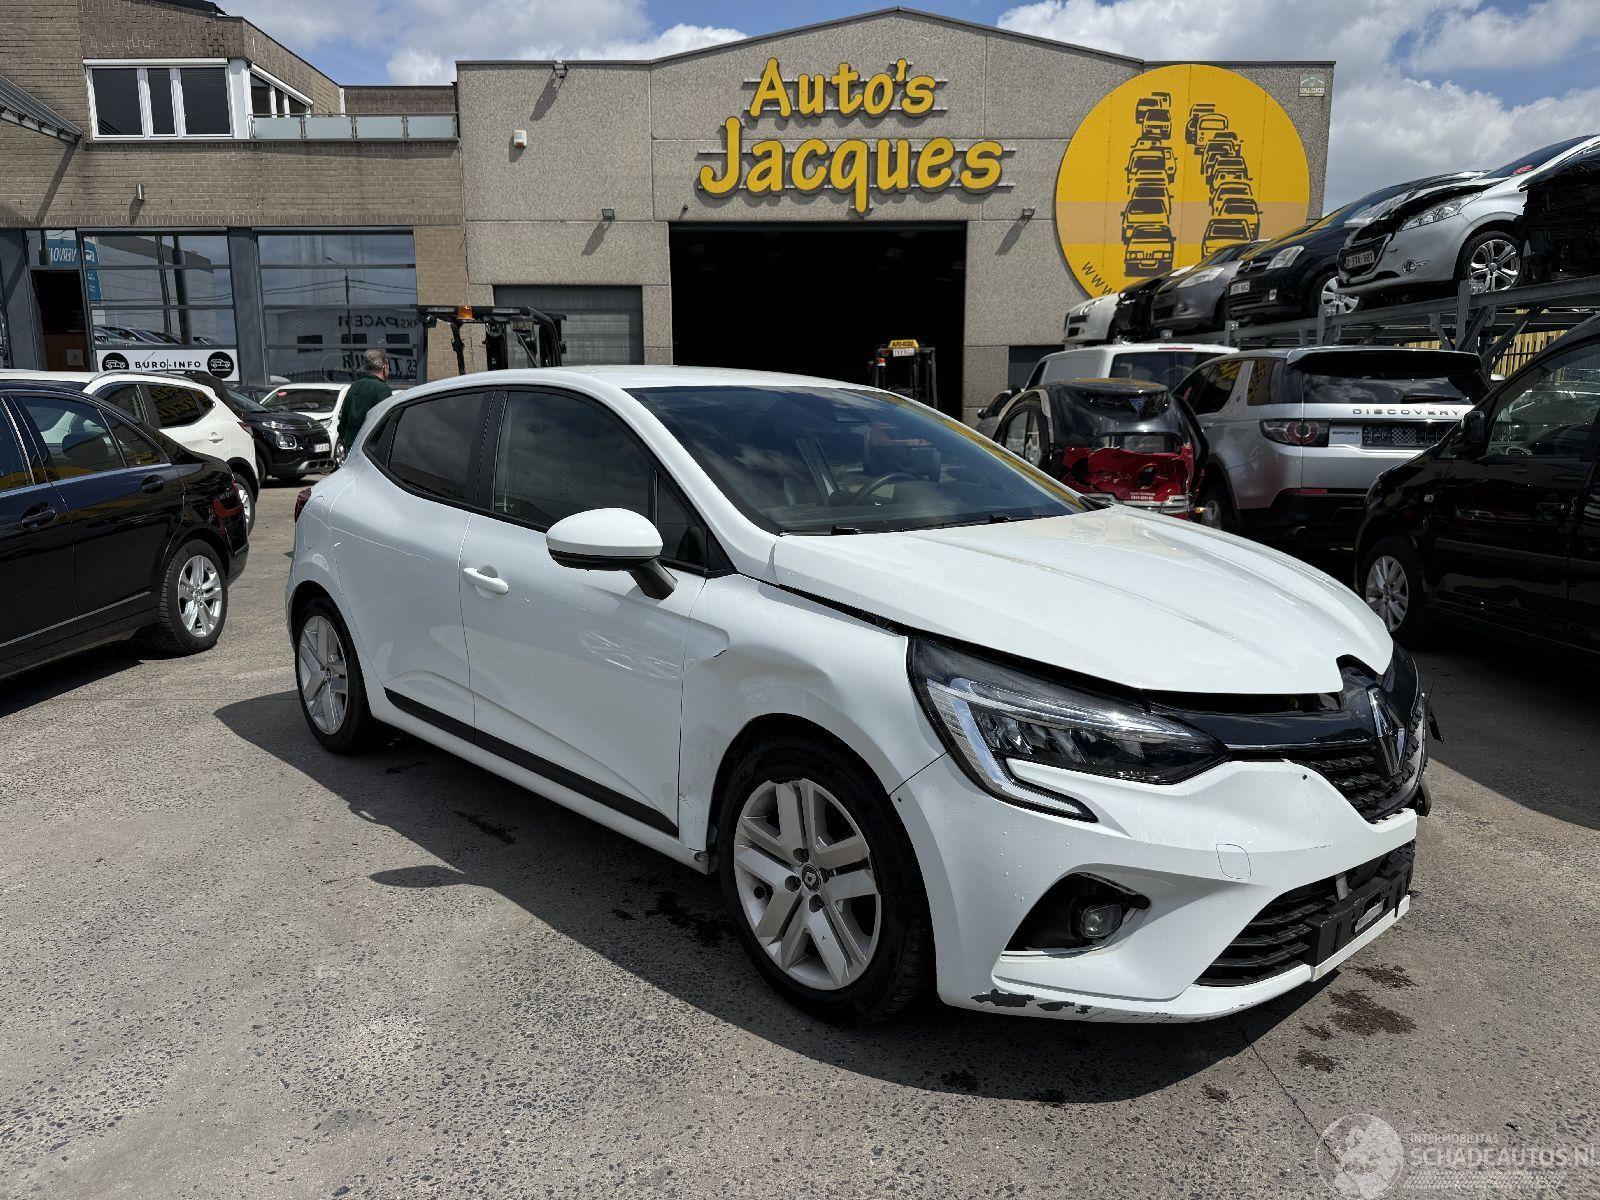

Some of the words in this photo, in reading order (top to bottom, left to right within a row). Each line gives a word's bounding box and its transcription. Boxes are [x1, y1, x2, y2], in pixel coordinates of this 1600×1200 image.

[750, 57, 936, 117] Auto's
[700, 117, 1004, 213] Jacques
[1352, 408, 1460, 416] DISCOVERY
